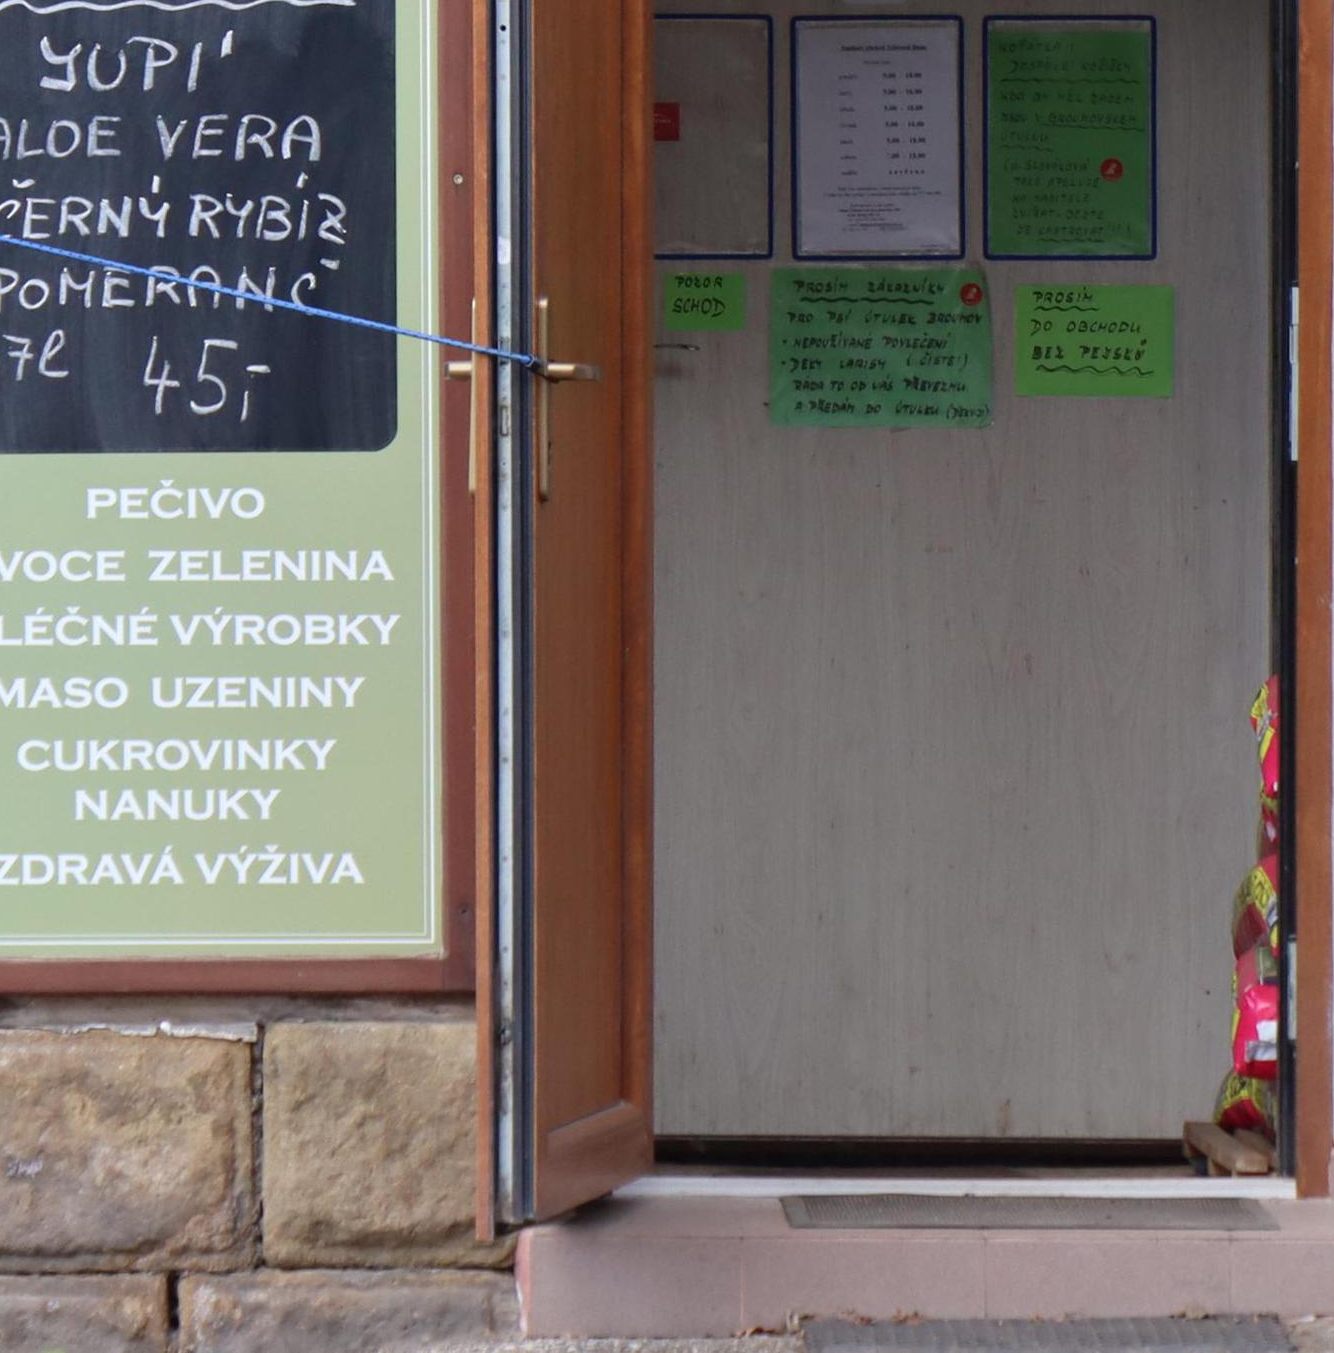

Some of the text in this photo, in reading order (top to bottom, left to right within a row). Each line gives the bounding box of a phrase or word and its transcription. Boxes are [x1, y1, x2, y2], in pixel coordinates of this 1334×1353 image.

[156, 115, 322, 160] VERA
[189, 172, 346, 244] RYBÍZ
[675, 276, 722, 288] POZOR
[792, 277, 848, 293] PROSÍM
[1033, 287, 1092, 303] PROSÍM
[672, 297, 726, 317] SCHOD
[1030, 319, 1140, 337] DO OBCHODU
[1032, 346, 1064, 360] BEZ
[86, 479, 265, 519] PEČIVO
[148, 550, 394, 581] ZELENINA
[169, 608, 400, 646] VÝROBKY
[151, 677, 365, 708] UZENINY
[16, 739, 337, 772] CUKROVINKY
[74, 789, 280, 820] NANUKY
[194, 845, 365, 885] VÝŽIVA
